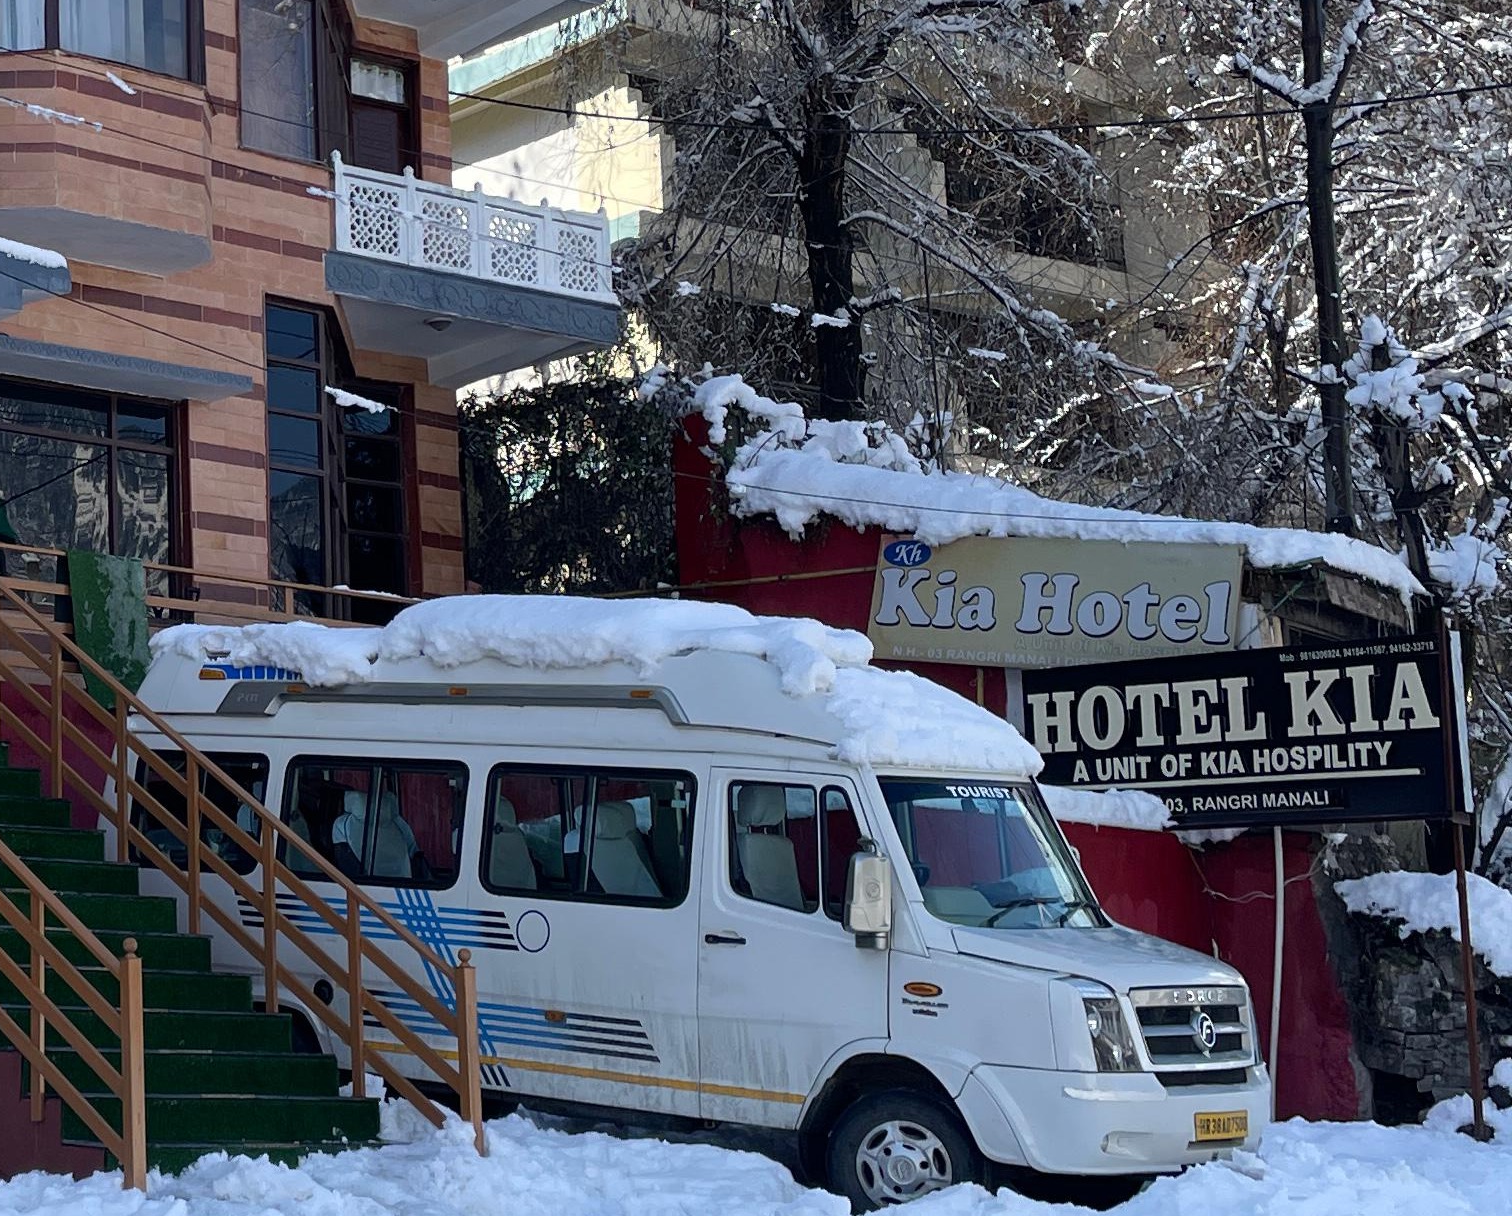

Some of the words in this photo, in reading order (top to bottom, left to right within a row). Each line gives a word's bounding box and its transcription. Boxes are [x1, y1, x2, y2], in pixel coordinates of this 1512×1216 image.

[893, 543, 922, 565] Kh
[874, 568, 997, 632] Kia
[1014, 572, 1232, 647] Hotel
[946, 649, 1001, 663] RANGRI
[1004, 652, 1060, 666] MANALI
[1027, 676, 1267, 754] HOTEL
[1283, 662, 1441, 739] KIA
[1073, 760, 1090, 783] A
[1095, 756, 1152, 781] UNIT
[1160, 753, 1193, 778] OF
[1201, 750, 1246, 775] KIA
[1253, 741, 1393, 773] HOSPILITY
[945, 786, 1011, 799] TOURIST
[1192, 794, 1258, 812] RANGRI
[1261, 791, 1329, 809] MANALI
